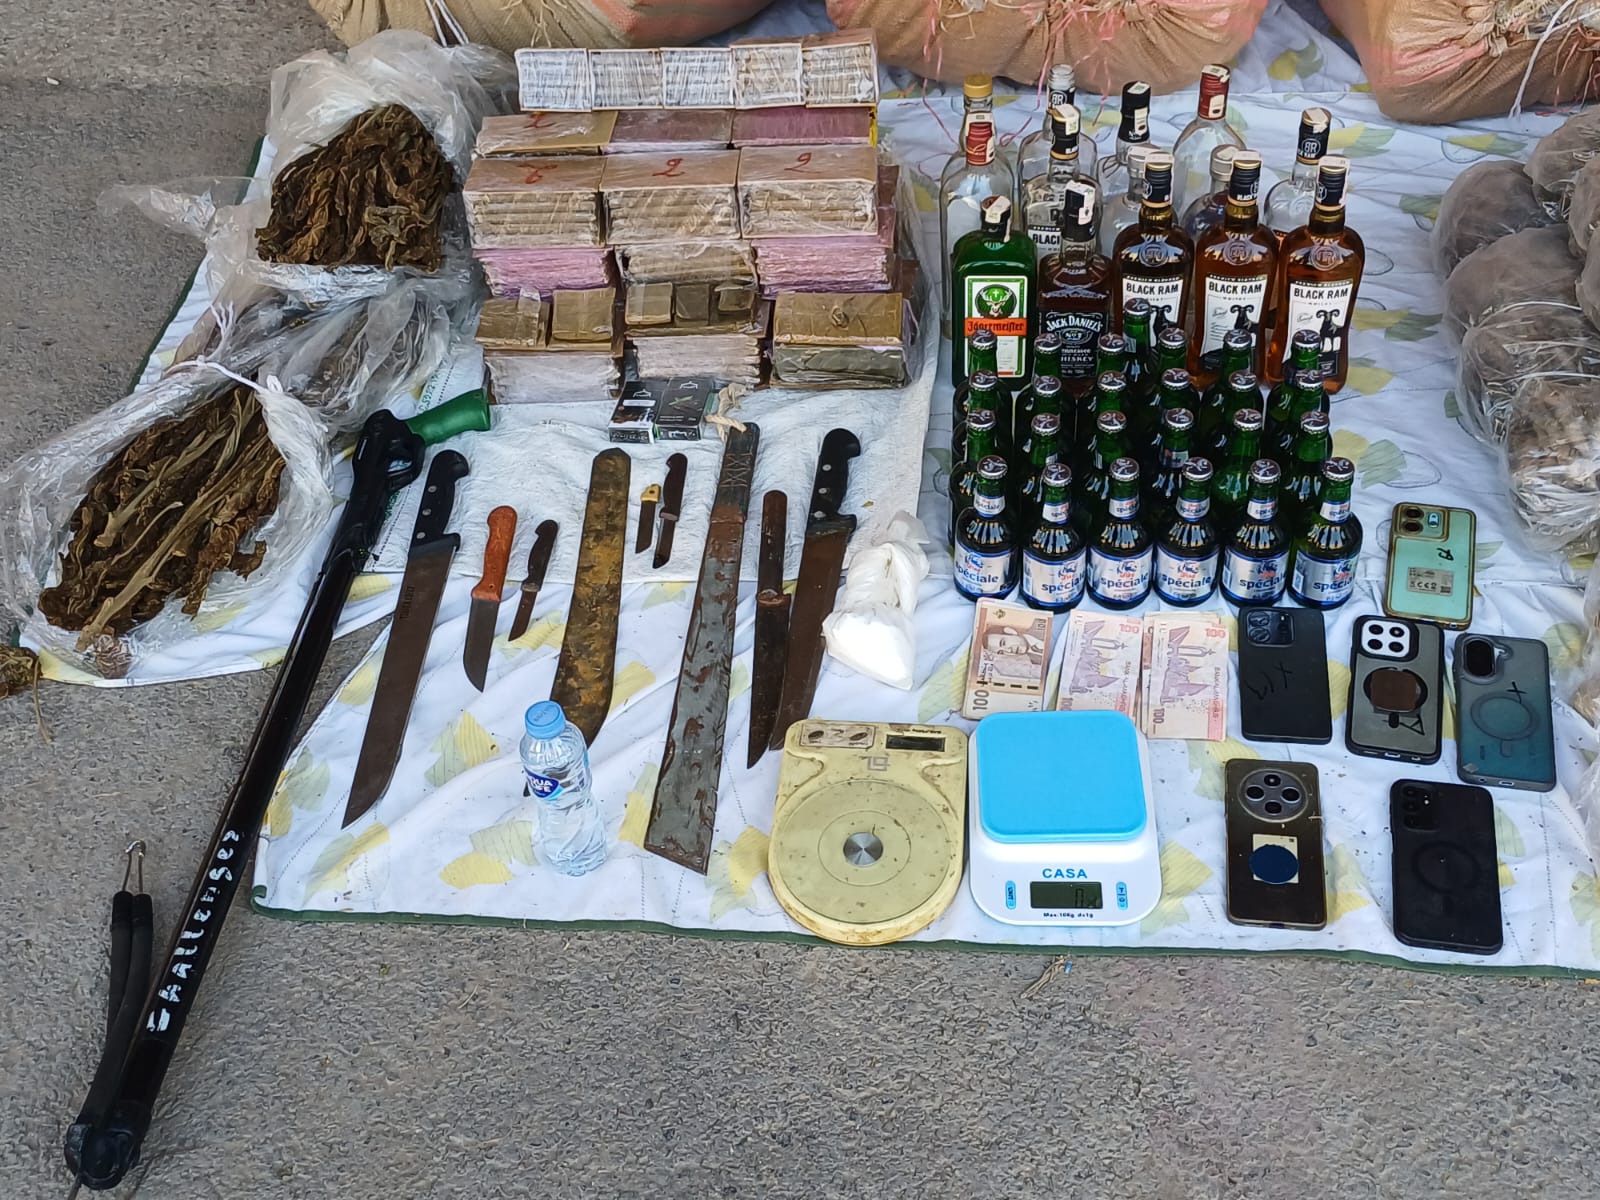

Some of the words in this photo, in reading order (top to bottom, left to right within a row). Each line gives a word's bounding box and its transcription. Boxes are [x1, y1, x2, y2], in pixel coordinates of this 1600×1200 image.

[1126, 282, 1155, 295] BLACK
[1158, 284, 1179, 295] RAM
[1209, 281, 1239, 294] BLACK
[1241, 283, 1262, 295] RAM
[1294, 288, 1325, 299] BLACK
[1327, 287, 1348, 299] RAM
[1046, 317, 1069, 331] JACK
[972, 689, 990, 711] 100
[1042, 868, 1088, 879] CASA
